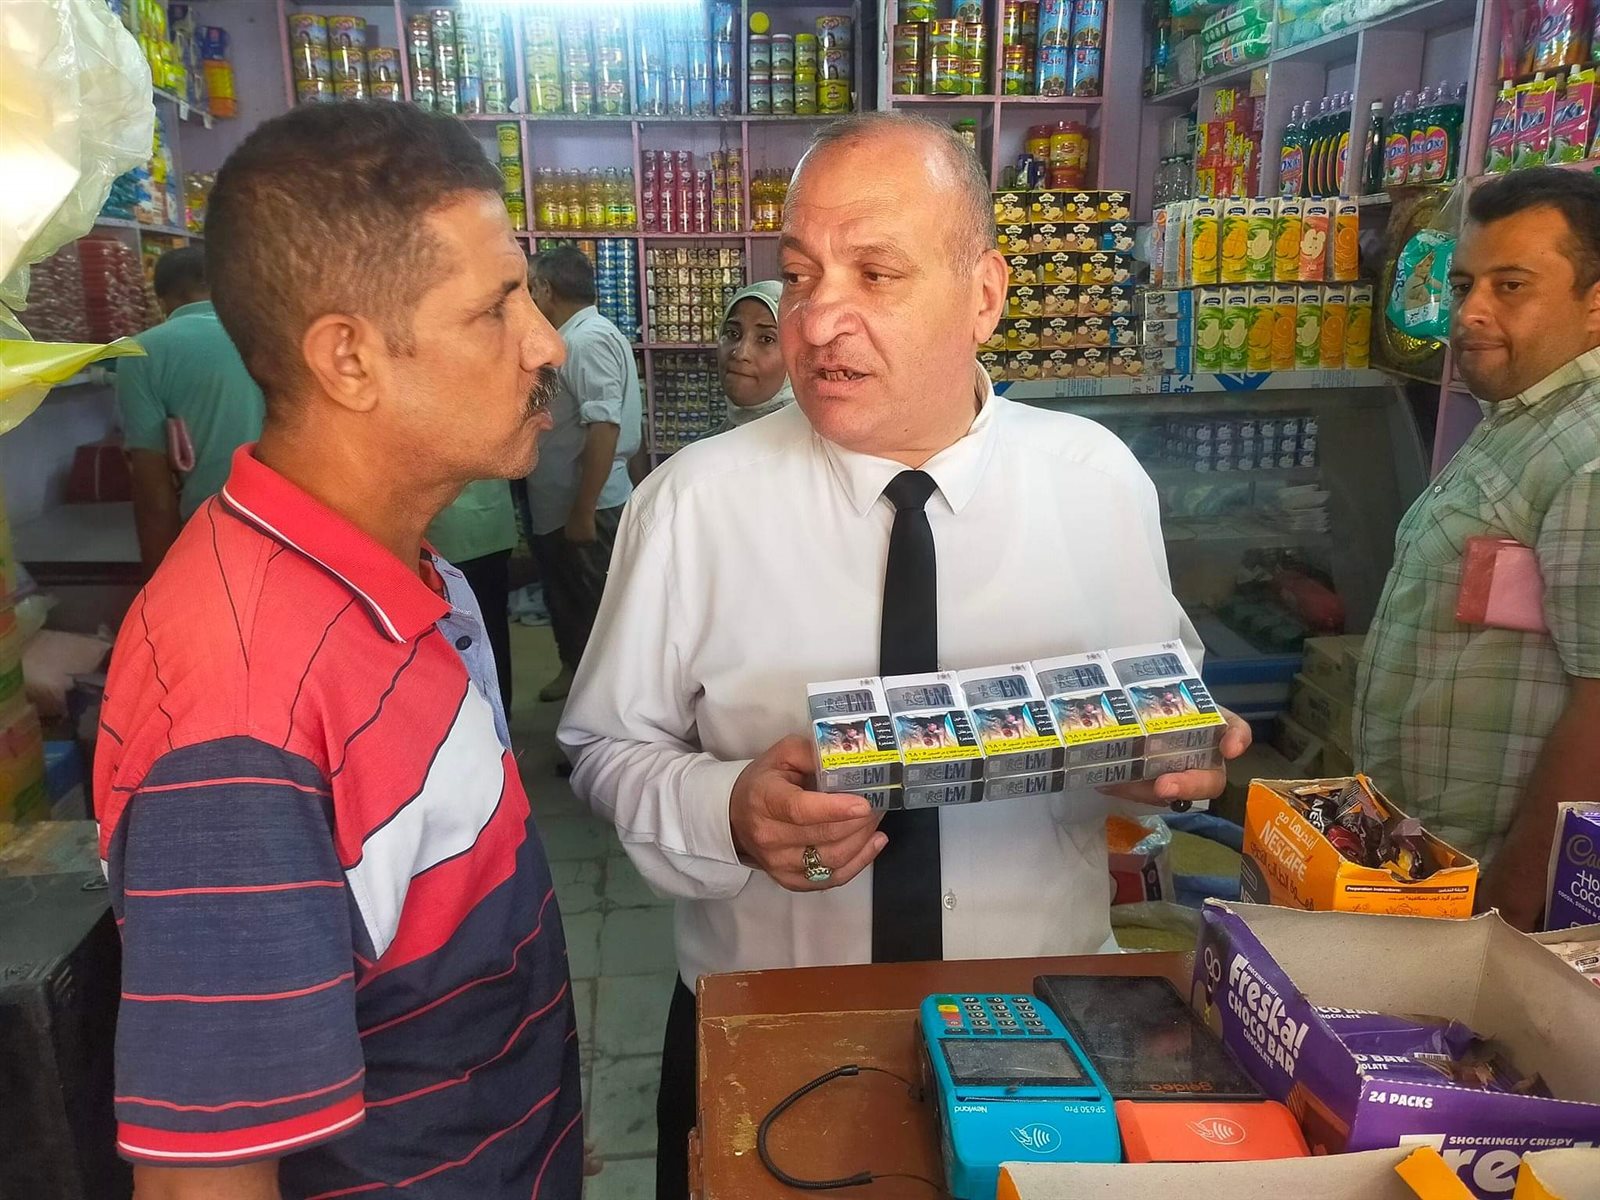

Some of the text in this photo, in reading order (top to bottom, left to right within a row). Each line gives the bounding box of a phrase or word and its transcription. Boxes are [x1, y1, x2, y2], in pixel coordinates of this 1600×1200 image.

[1576, 870, 1600, 891] Ho
[1571, 882, 1600, 908] Coco
[1230, 953, 1309, 1059] Freska!
[1228, 990, 1294, 1078] CHOCO BAR
[1243, 1028, 1274, 1069] CHOCOLATE
[954, 1105, 988, 1113] Newland
[1064, 1105, 1106, 1113] SP630 Pro
[1368, 1091, 1434, 1109] 24 PACKS
[1449, 1136, 1574, 1147] SHOCKINGLY CRISPY
